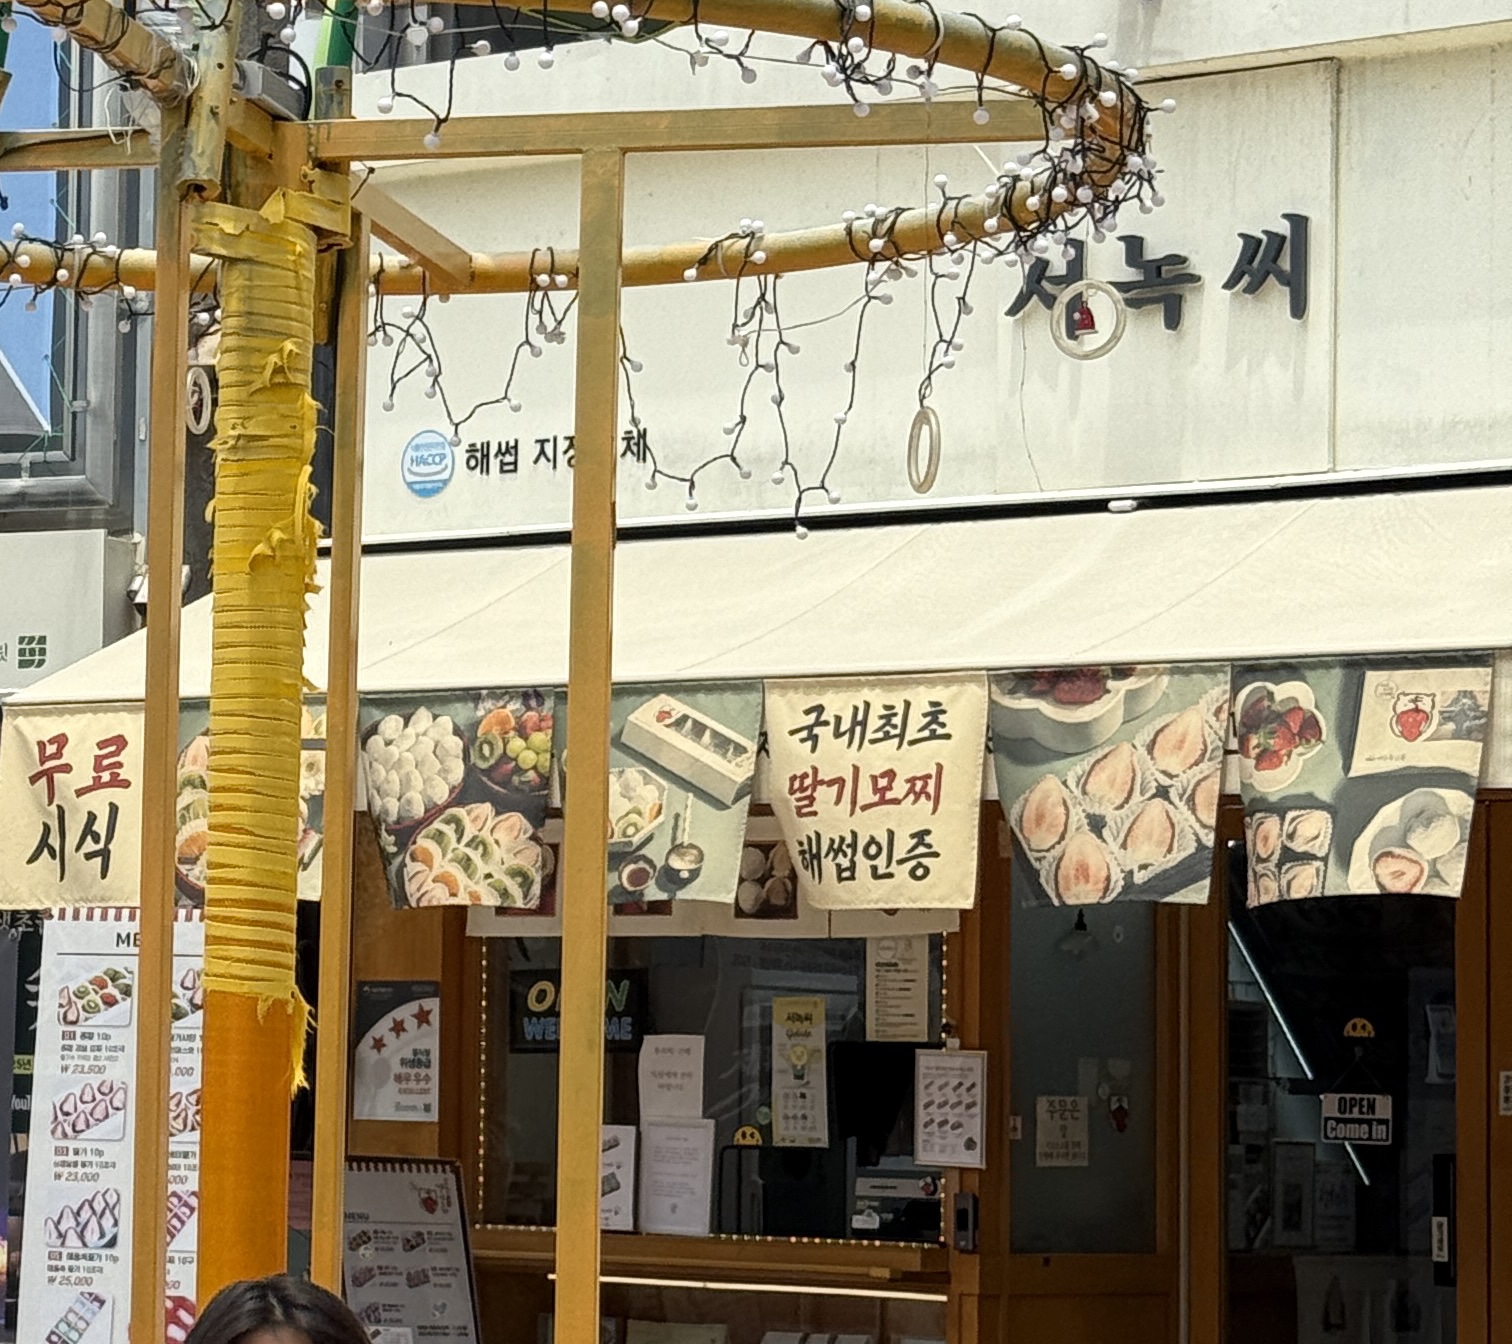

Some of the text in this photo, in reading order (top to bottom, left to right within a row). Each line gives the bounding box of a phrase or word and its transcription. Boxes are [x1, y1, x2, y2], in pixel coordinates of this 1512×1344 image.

[465, 427, 648, 476] 해썹 지정체
[787, 698, 953, 754] 국내최초
[28, 732, 132, 807] 무료
[788, 762, 944, 818] 딸기모찌
[25, 801, 120, 883] 시식
[796, 828, 941, 885] 해썹인증
[527, 980, 630, 1012] ON
[1327, 1119, 1387, 1140] Come in
[1337, 1096, 1377, 1116] OPEN
